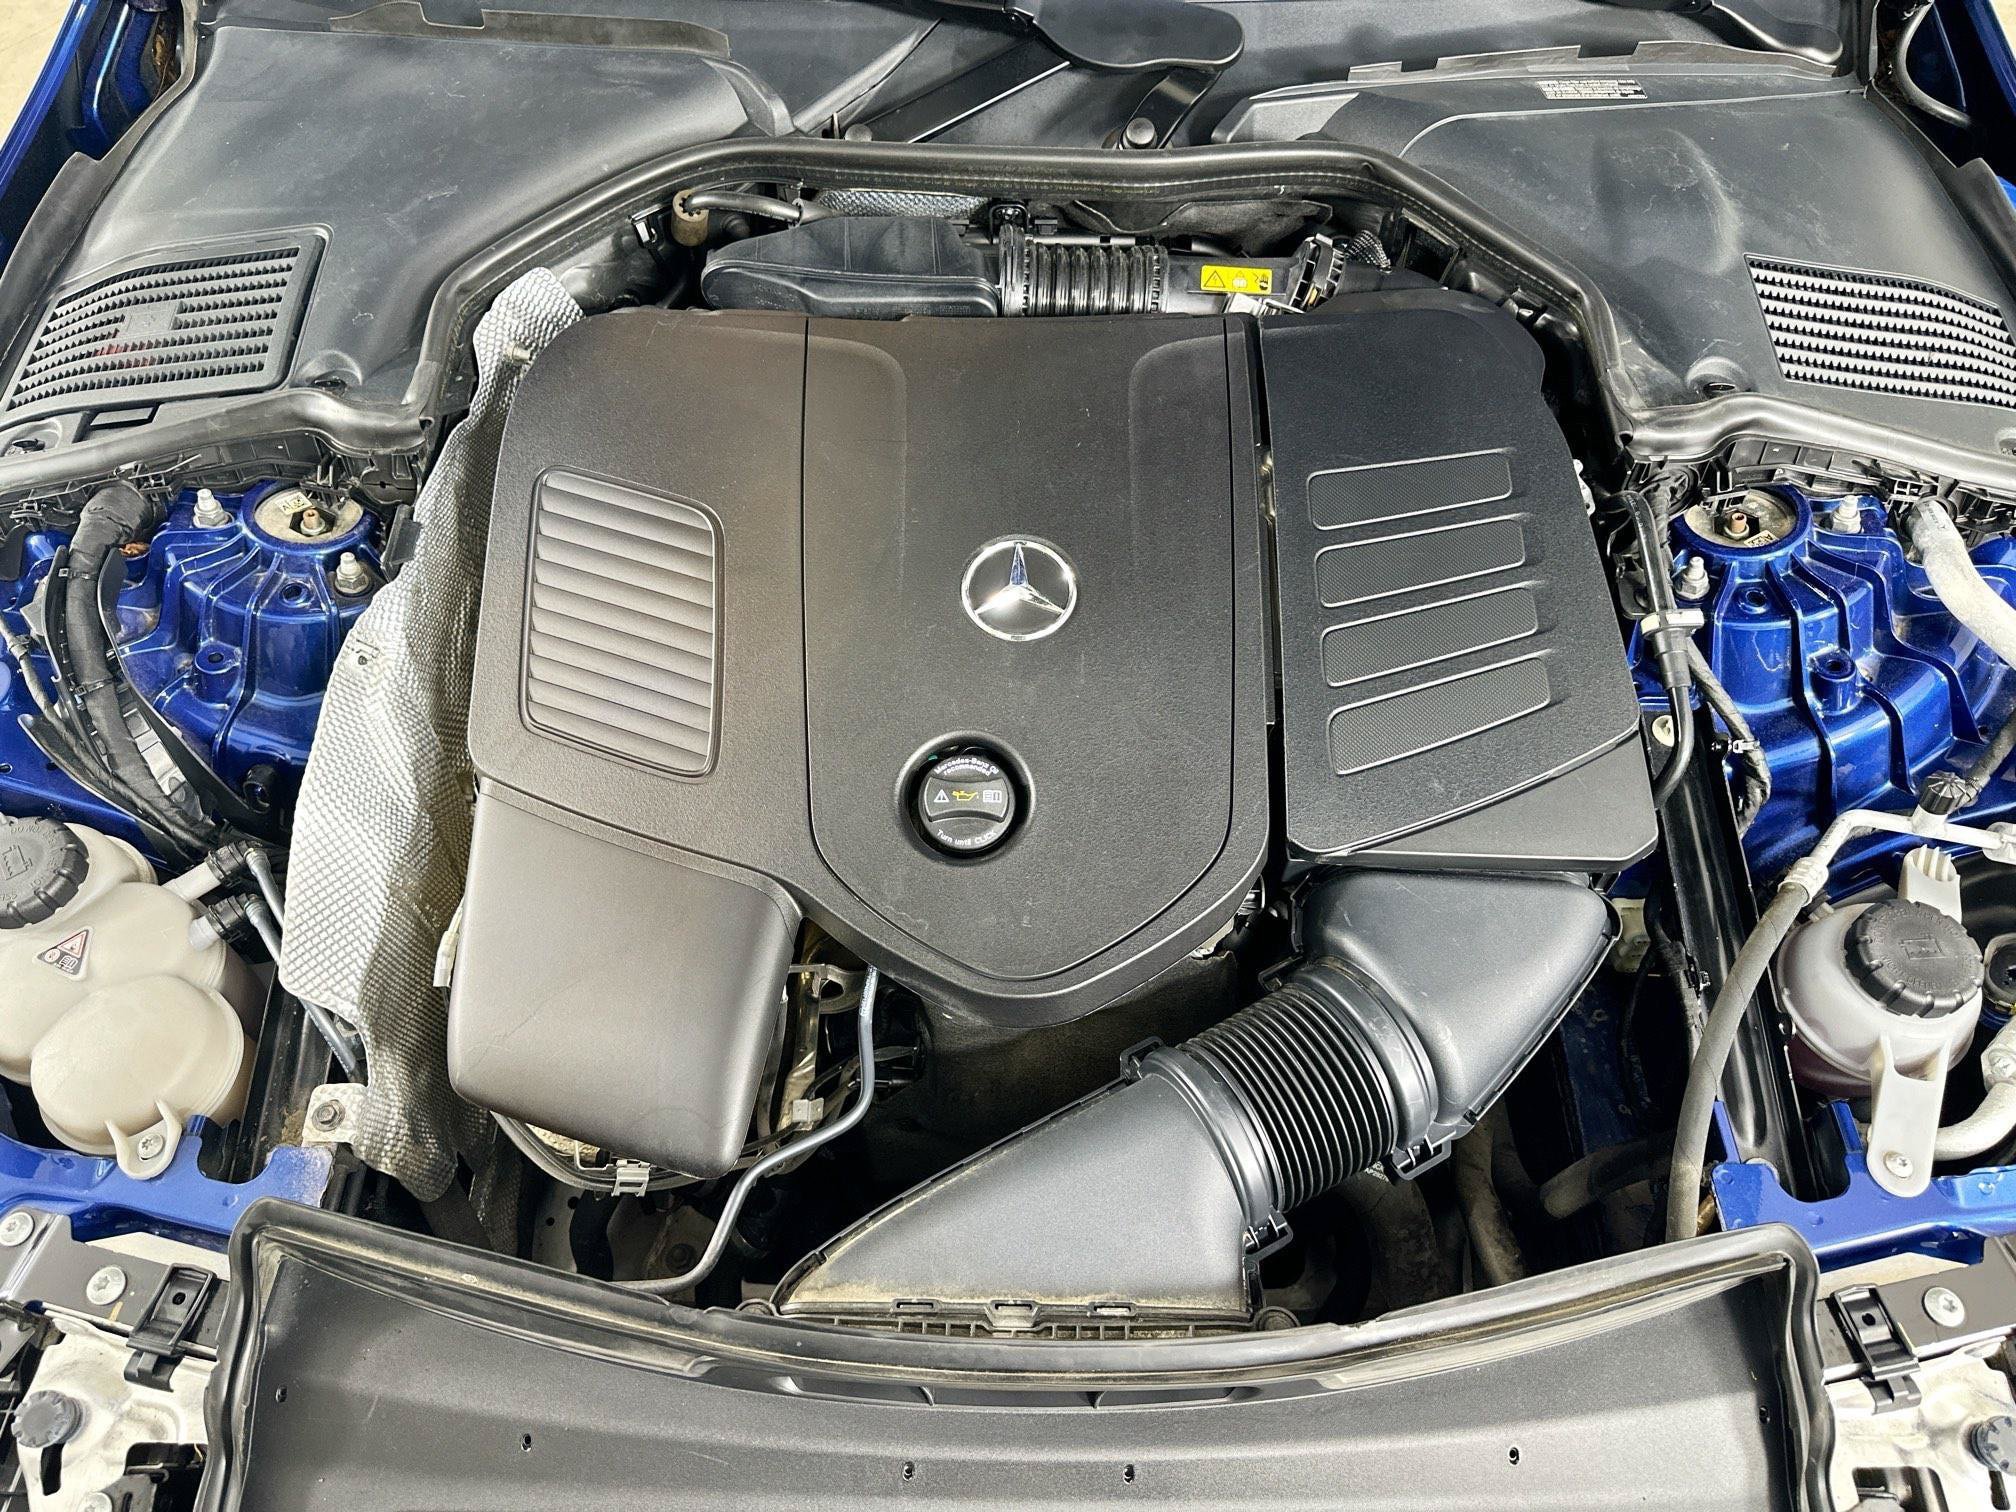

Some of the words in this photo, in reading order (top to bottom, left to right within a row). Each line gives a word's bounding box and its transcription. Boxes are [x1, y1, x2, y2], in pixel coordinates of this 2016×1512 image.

[934, 758, 989, 774] Mercedes-Benz
[944, 764, 990, 776] recommended
[937, 829, 953, 843] Turn
[975, 829, 997, 843] CLICK
